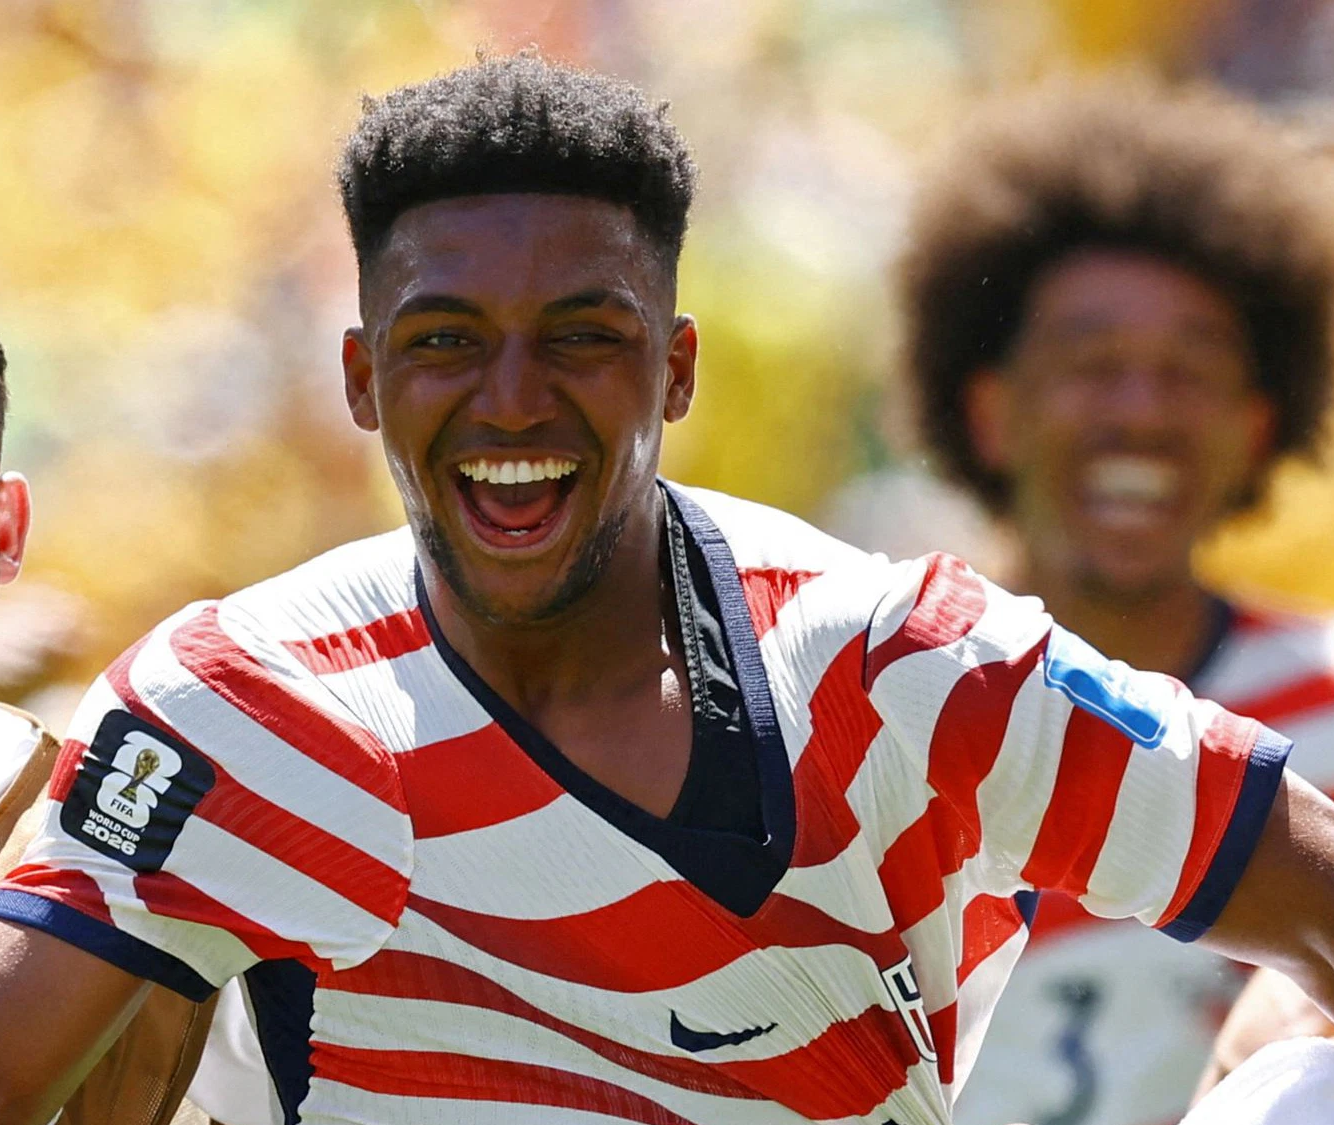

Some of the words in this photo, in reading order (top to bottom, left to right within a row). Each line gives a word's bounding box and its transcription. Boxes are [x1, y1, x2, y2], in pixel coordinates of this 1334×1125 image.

[88, 808, 123, 834] WORLD
[120, 827, 141, 843] CUP
[110, 798, 134, 818] FIFA
[81, 818, 138, 857] 2026
